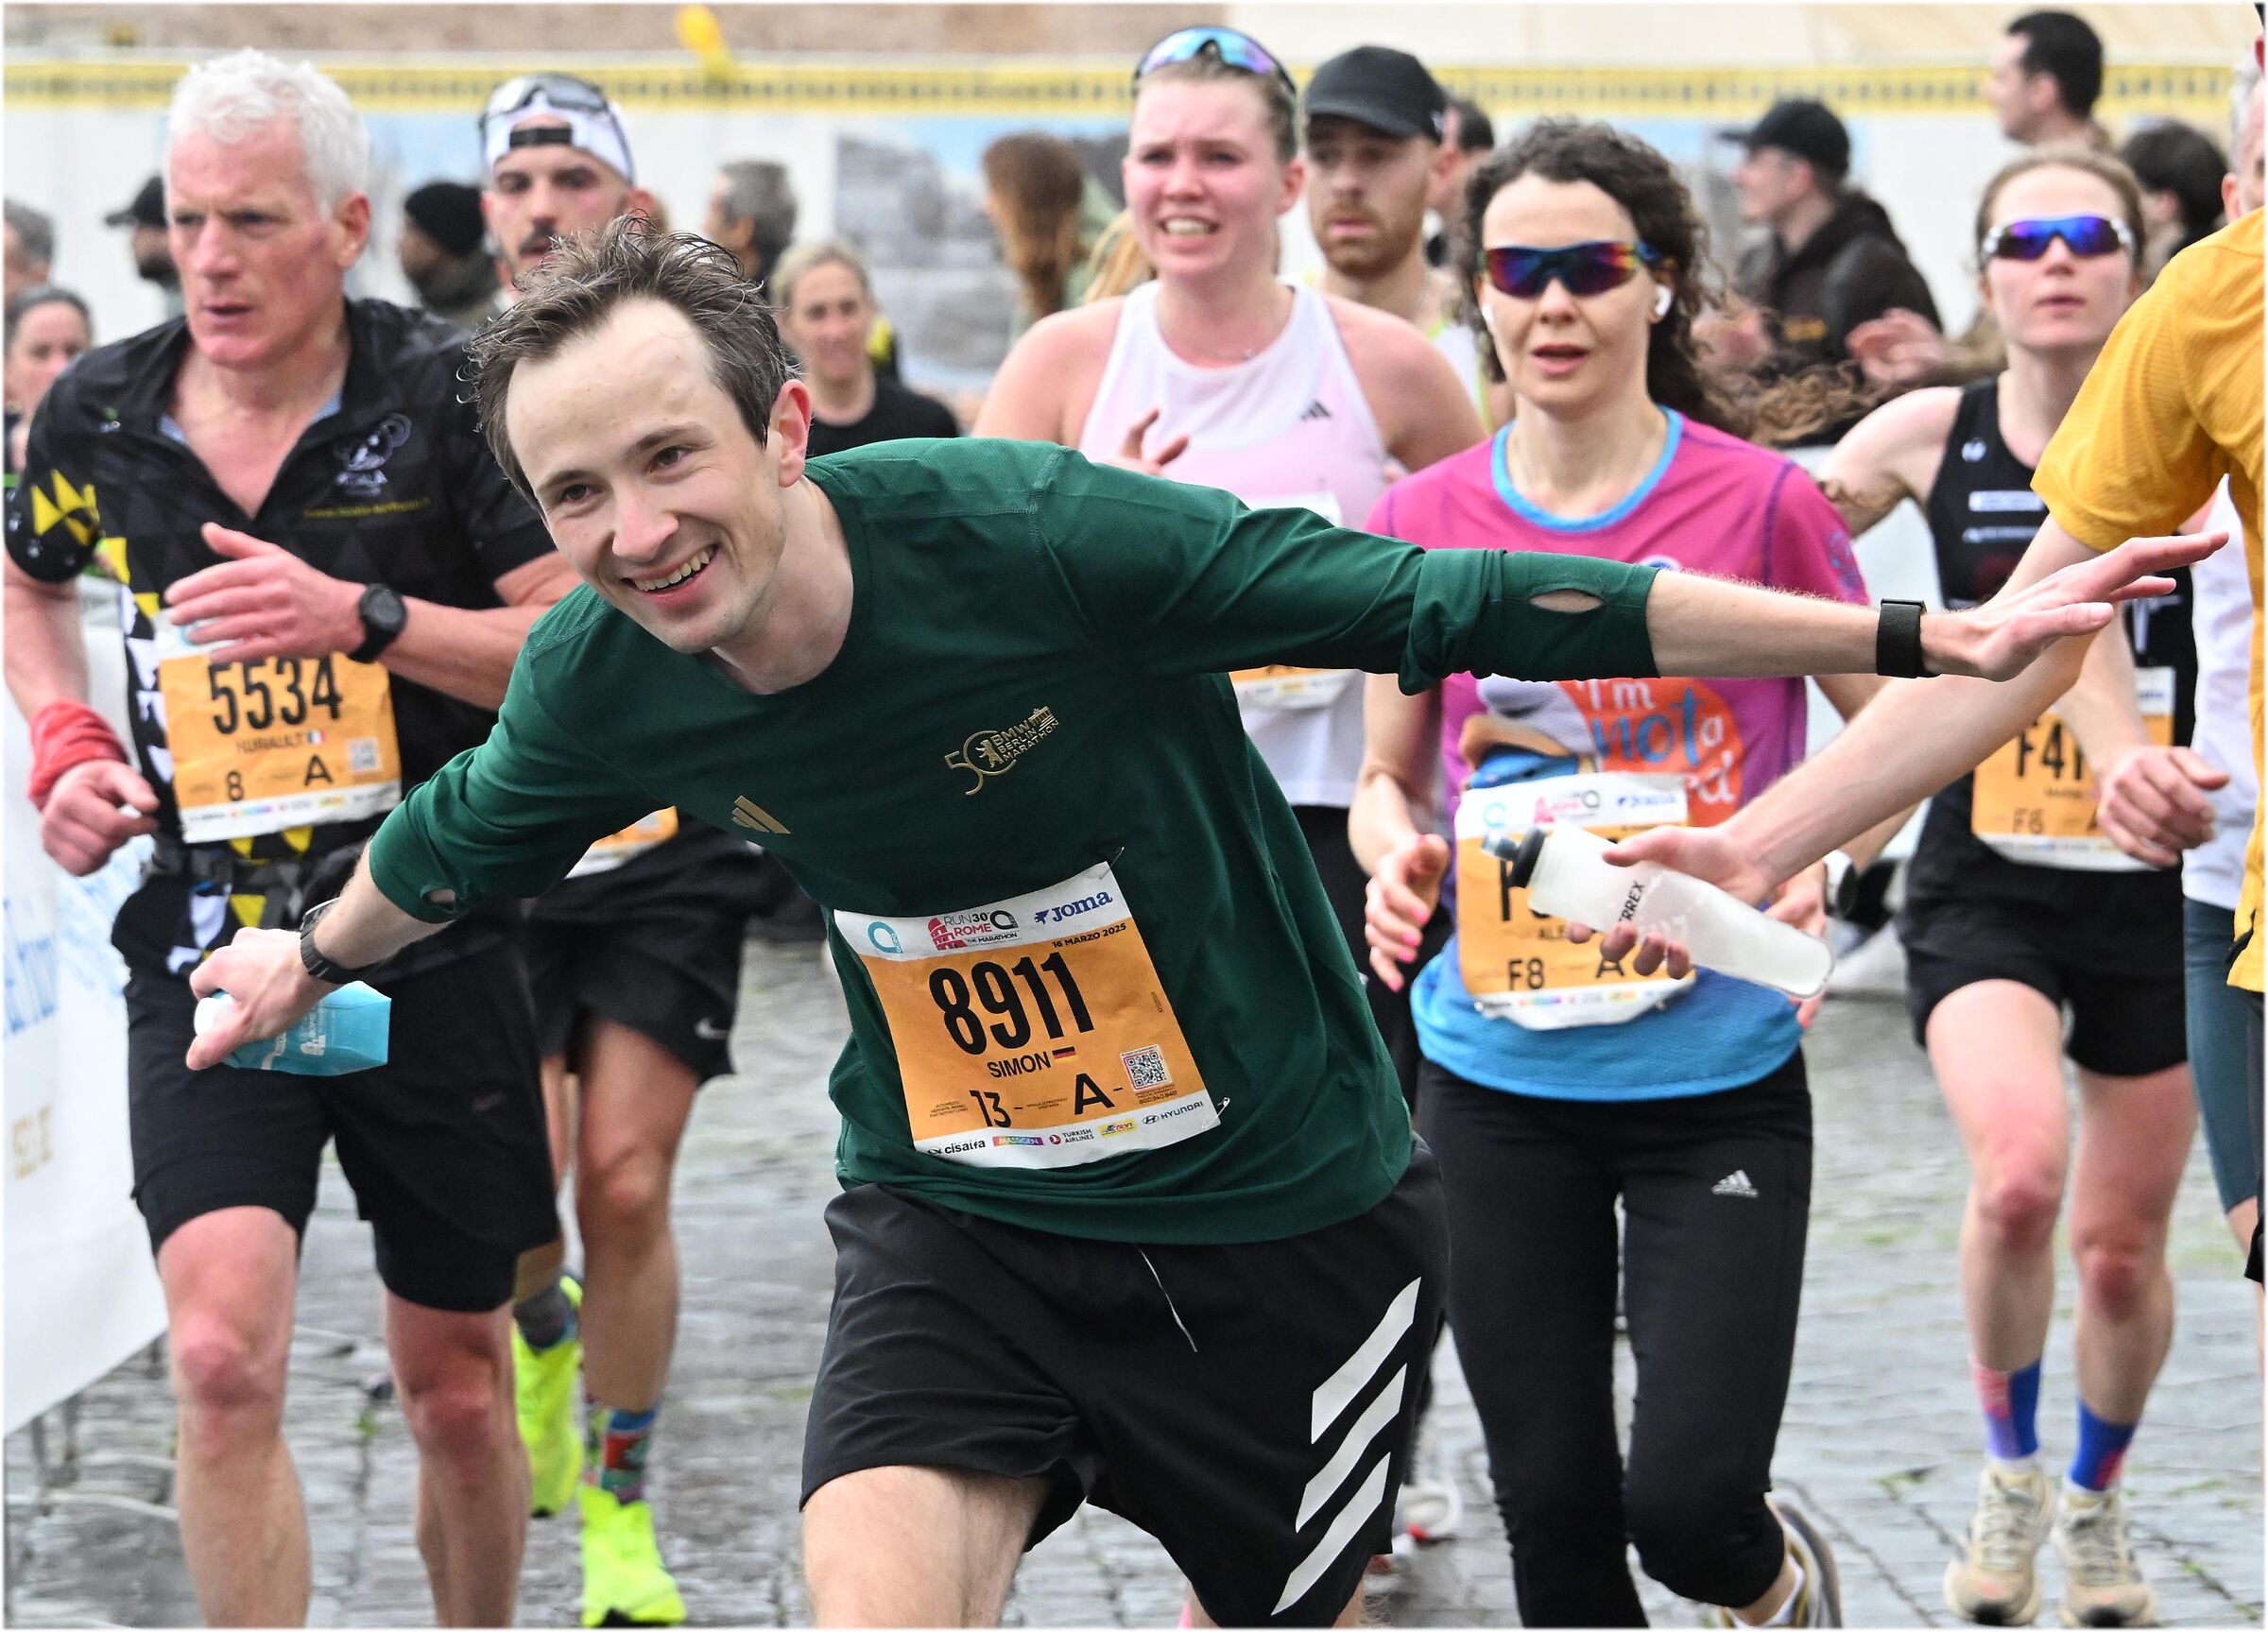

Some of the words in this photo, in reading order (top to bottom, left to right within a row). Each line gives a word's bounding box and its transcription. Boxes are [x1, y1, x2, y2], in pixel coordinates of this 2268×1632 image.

[208, 656, 343, 735] 5534
[990, 719, 1030, 746] BMW
[997, 728, 1039, 754] BERLIN
[1592, 687, 1704, 766] not
[1002, 719, 1060, 764] MARATHON
[304, 754, 334, 787] A
[226, 770, 244, 802] 8
[954, 923, 992, 936] ROME
[978, 932, 1018, 943] MARATHON
[1064, 932, 1101, 946] MARZO
[1103, 922, 1126, 937] 2025
[1509, 957, 1546, 990] F8
[929, 952, 1094, 1055] 8911
[988, 1051, 1052, 1078] SIMON
[969, 1090, 1011, 1127] 13
[1074, 1073, 1115, 1115] A
[1160, 1100, 1204, 1120] HYUNDAI
[1062, 1128, 1092, 1138] TURKISH
[1064, 1134, 1094, 1143] AIRLINES
